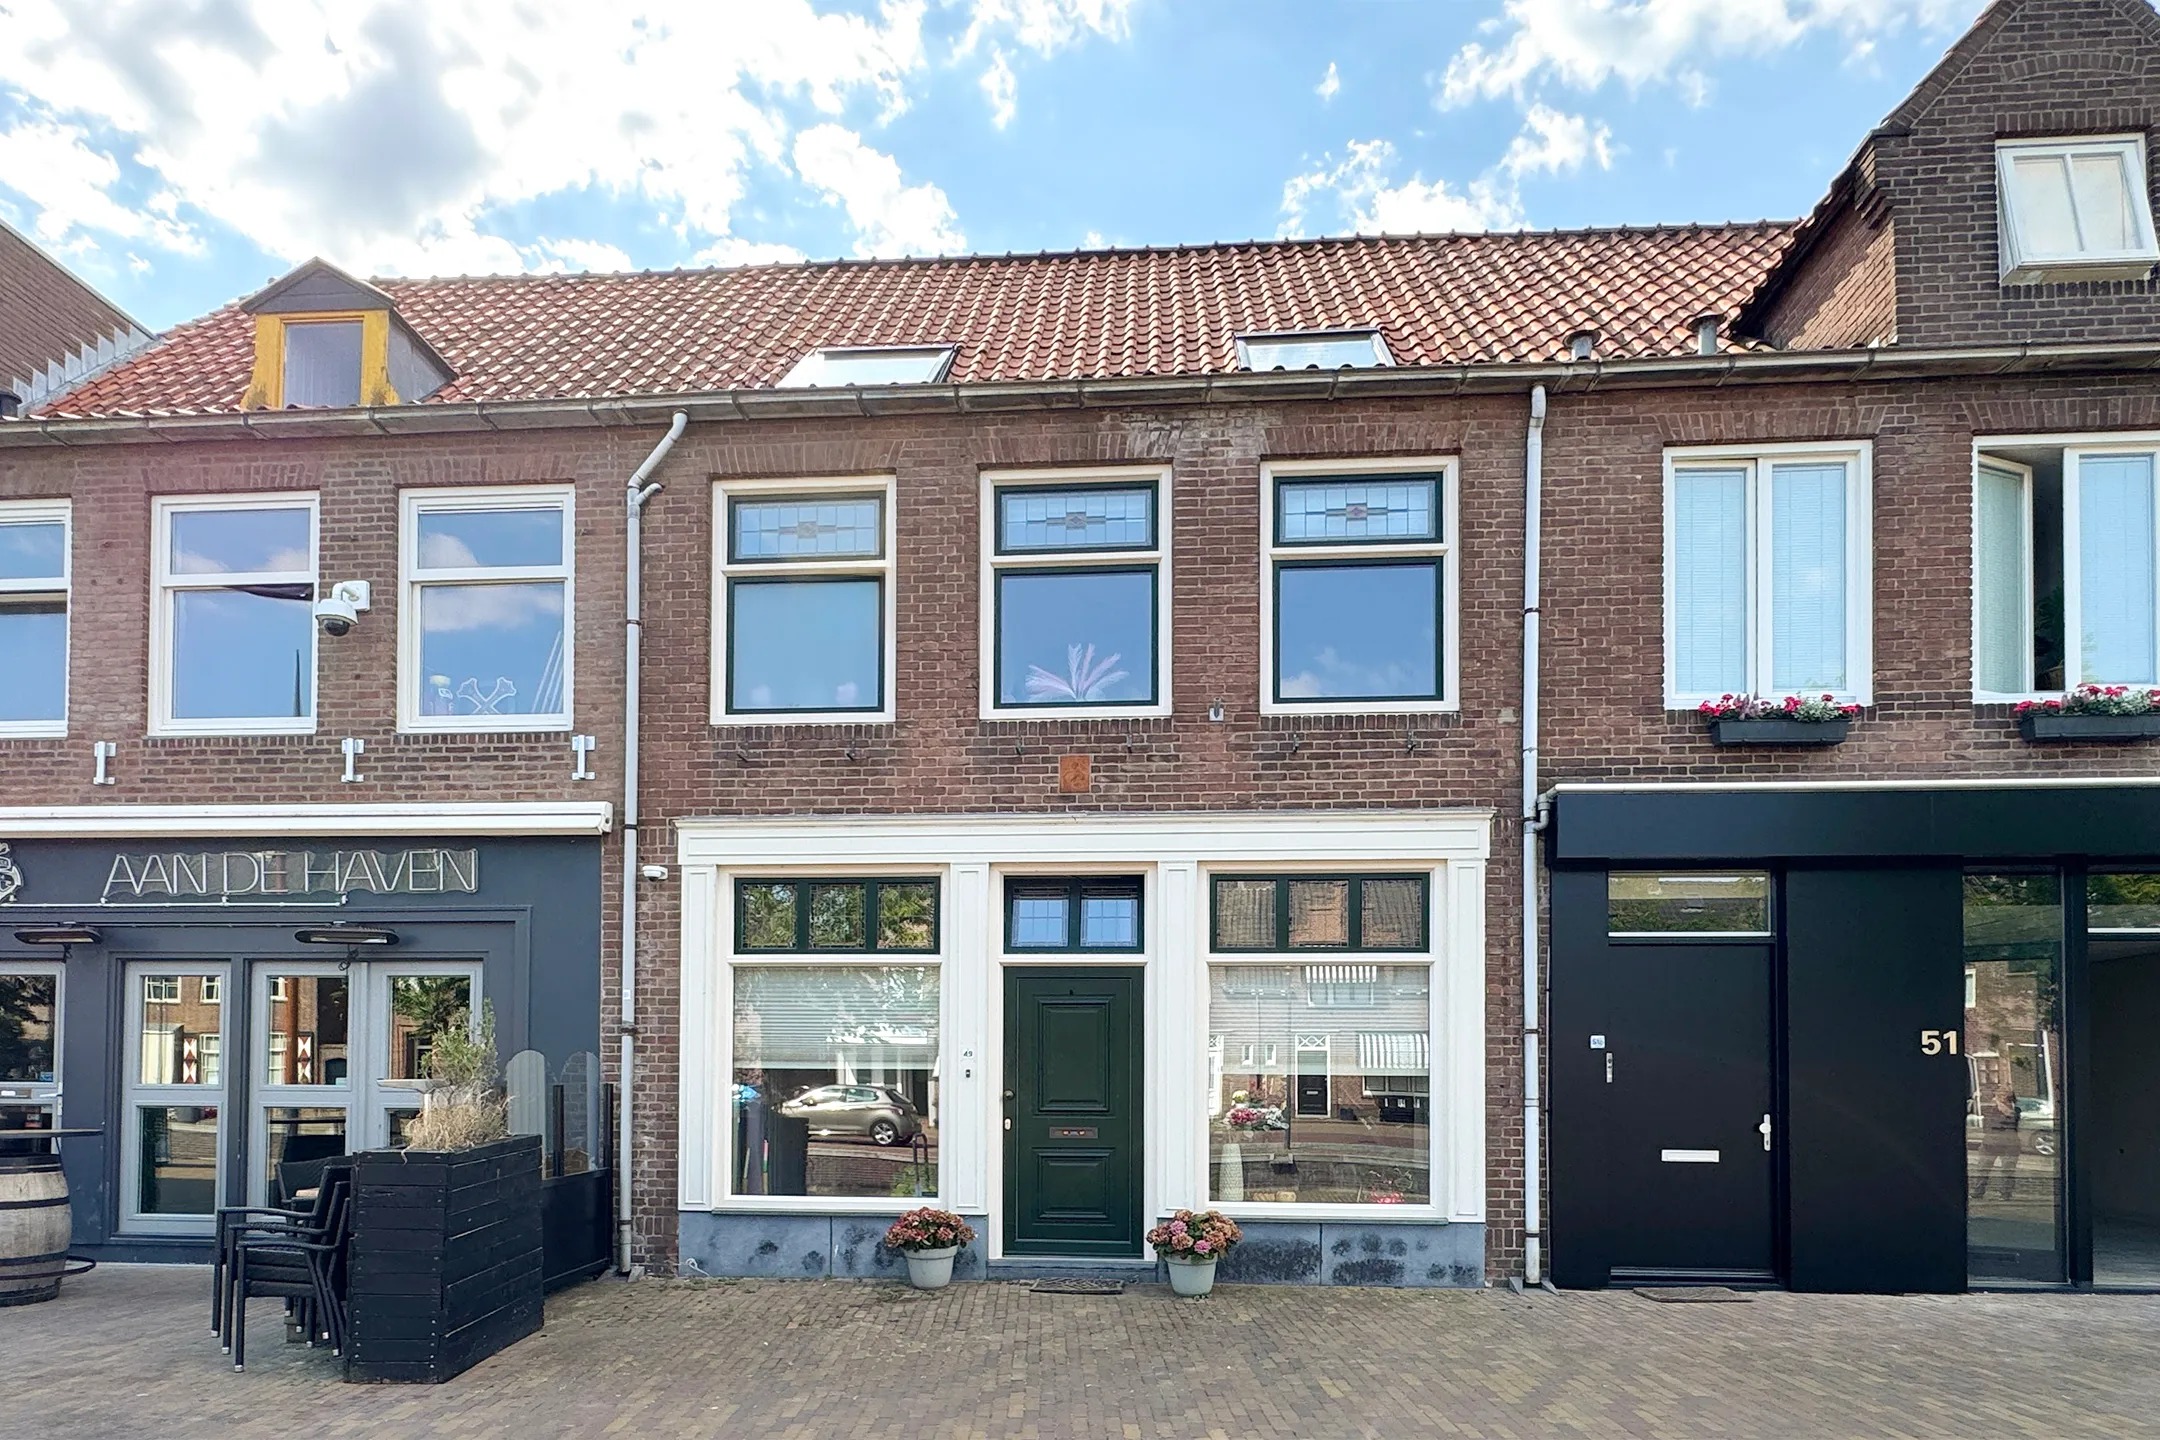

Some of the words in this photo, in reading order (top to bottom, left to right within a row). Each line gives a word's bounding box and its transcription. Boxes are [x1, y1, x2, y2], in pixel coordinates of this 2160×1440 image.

[102, 853, 208, 896] AAN
[222, 852, 288, 894] DE
[304, 849, 474, 892] HAVEN
[1921, 1030, 1957, 1056] 51
